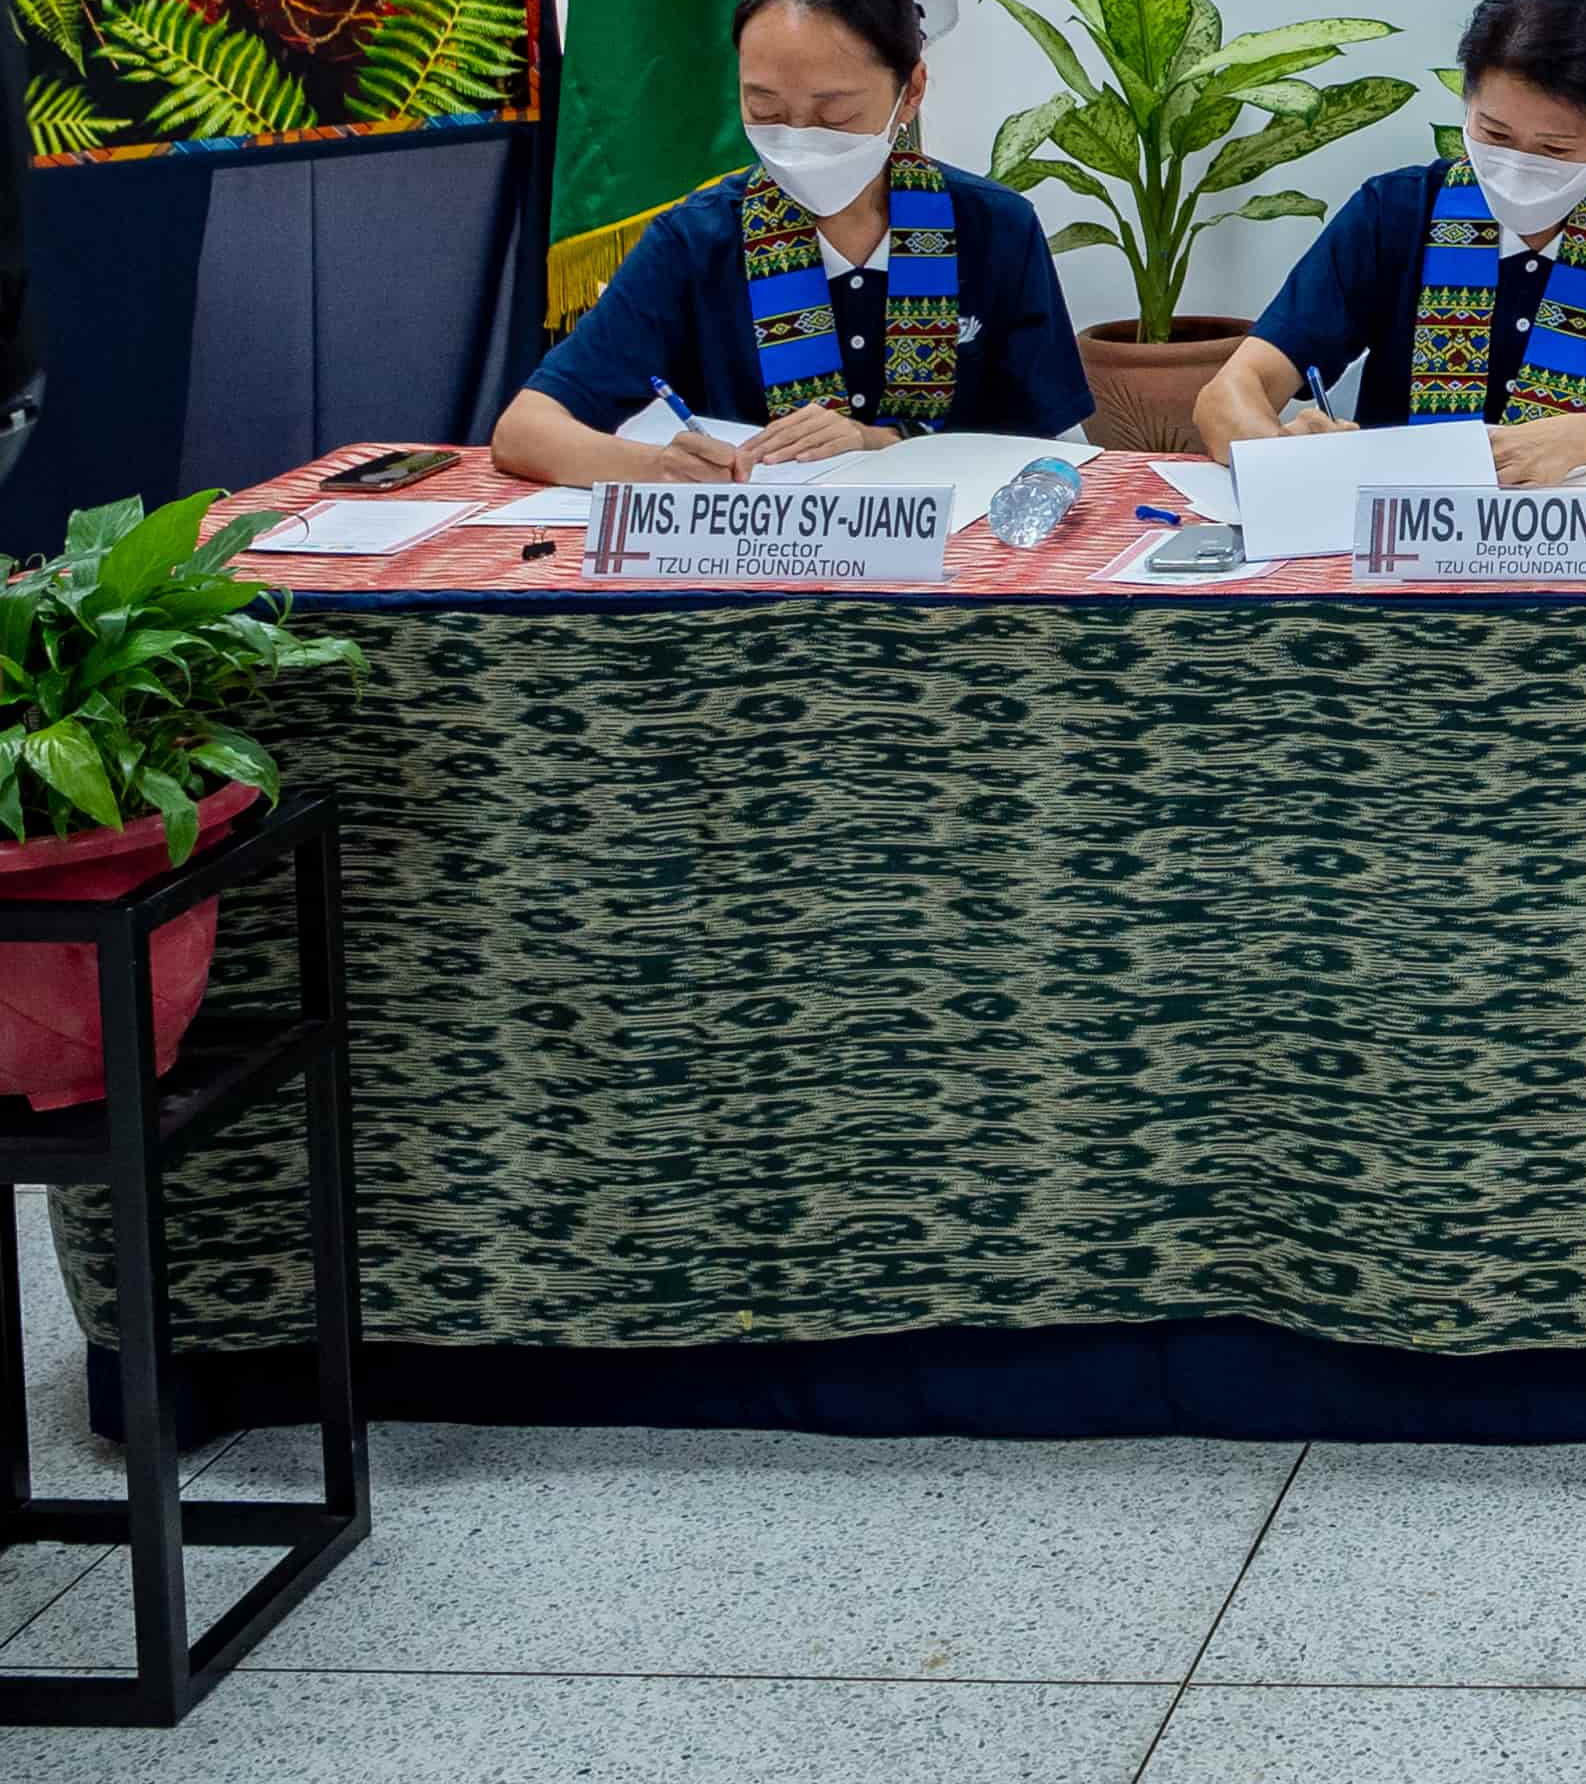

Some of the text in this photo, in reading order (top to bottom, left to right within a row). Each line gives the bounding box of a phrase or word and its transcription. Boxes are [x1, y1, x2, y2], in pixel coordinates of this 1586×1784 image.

[629, 492, 937, 539] MS. PEGGY SY-JIANG
[1398, 497, 1464, 542] MS.
[736, 538, 823, 558] Director
[1475, 541, 1569, 559] Deputy CEO
[656, 556, 866, 577] TZU CHI FOUNDATION
[1434, 560, 1464, 575] TZU
[1467, 560, 1495, 575] CHI
